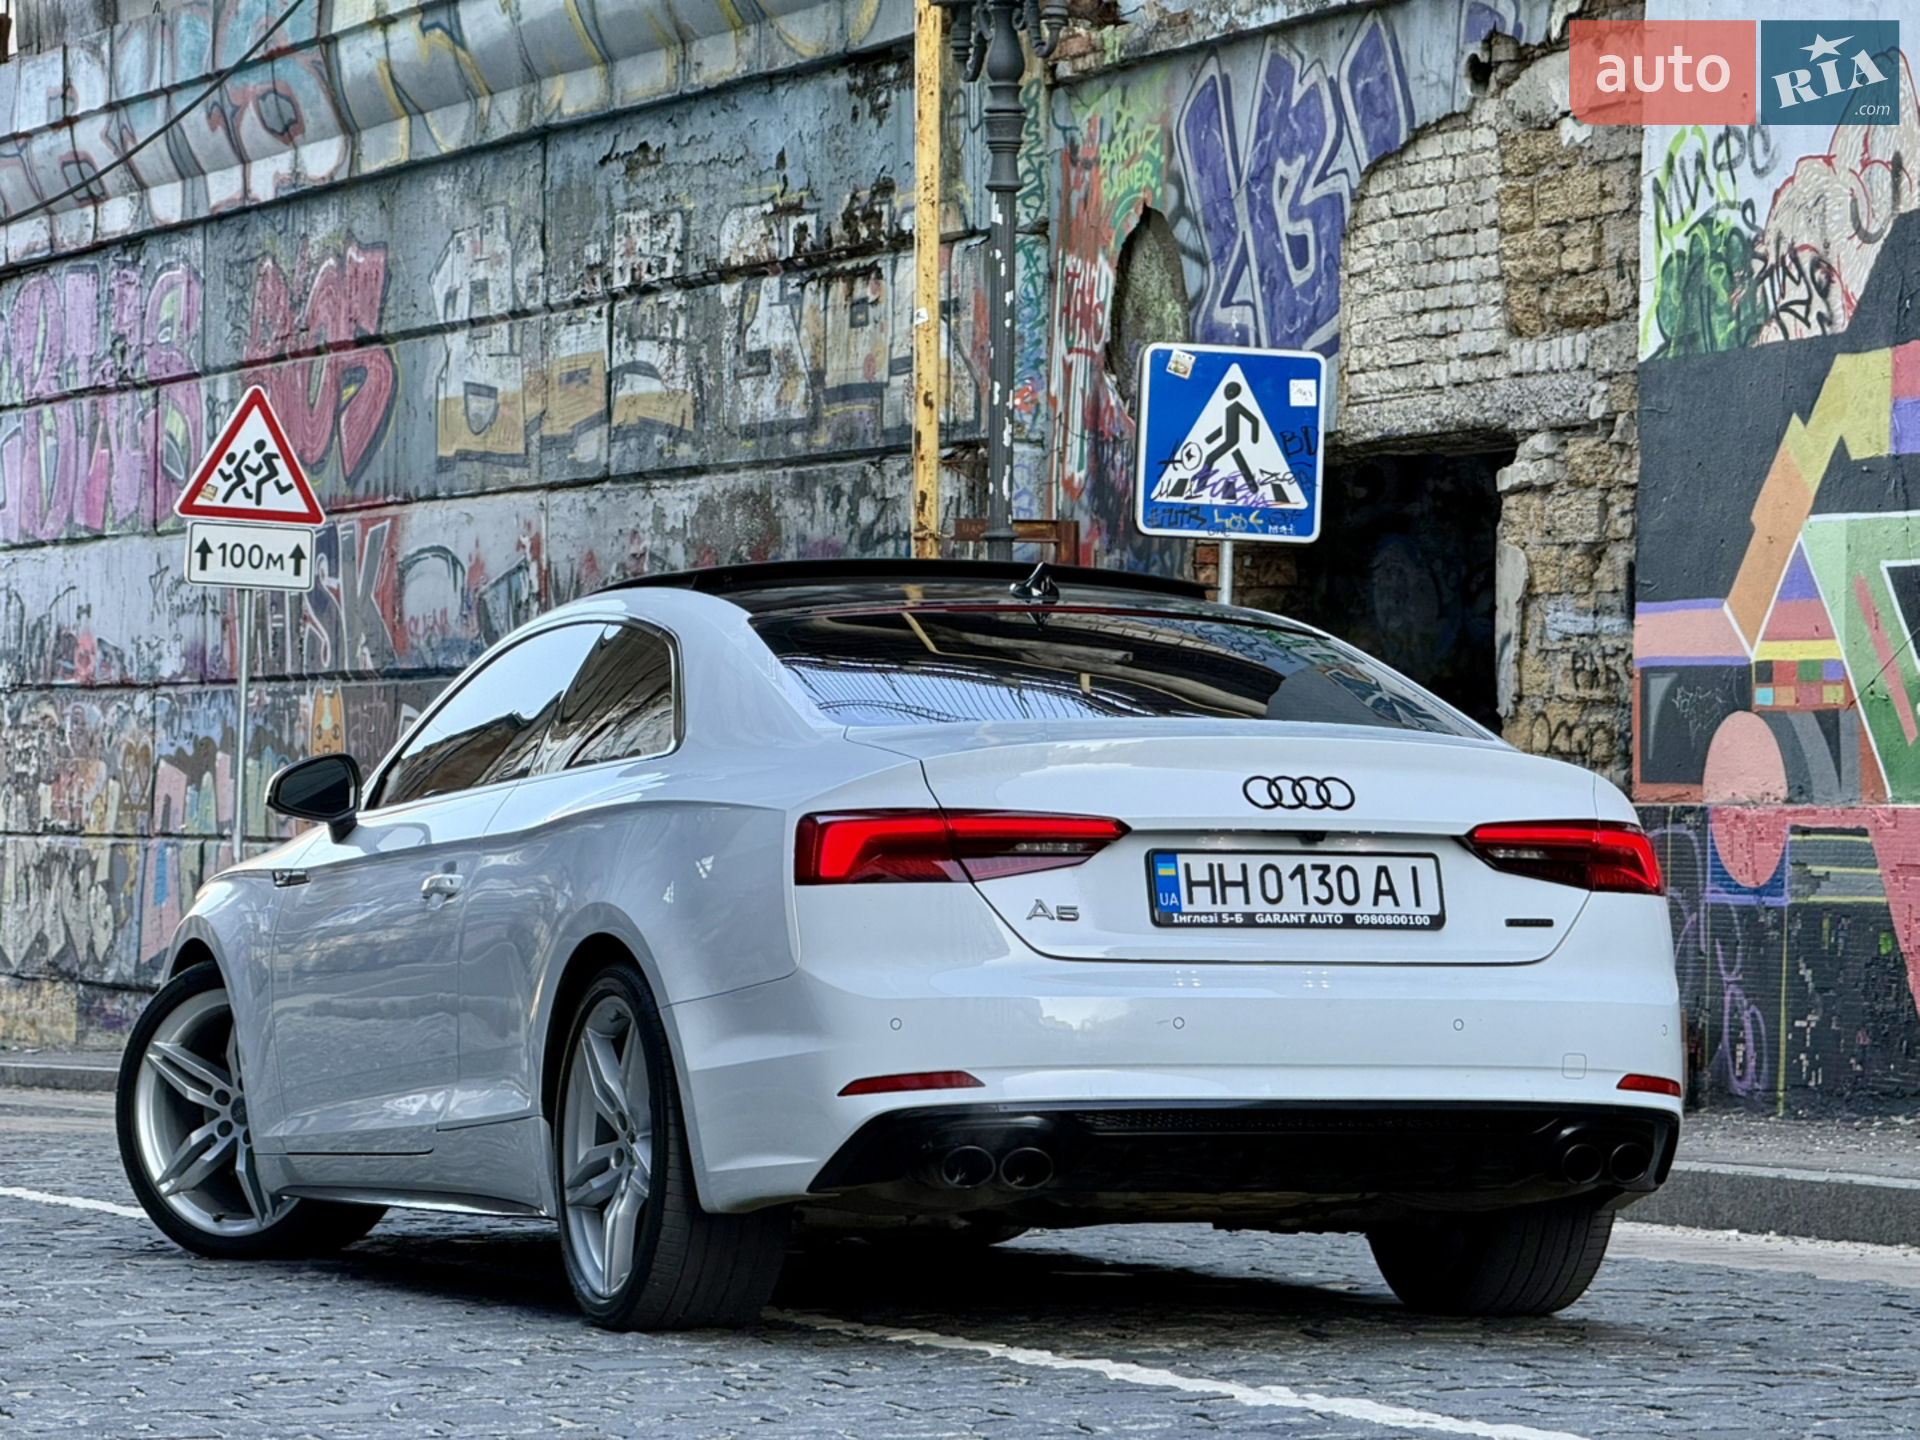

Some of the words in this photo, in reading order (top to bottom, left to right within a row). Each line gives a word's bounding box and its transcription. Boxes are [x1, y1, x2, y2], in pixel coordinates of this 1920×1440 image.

[1159, 892, 1180, 907] UA
[1026, 898, 1080, 922] A5
[1255, 913, 1306, 924] GARANT
[1309, 914, 1344, 924] AUTO
[1354, 914, 1431, 926] 0980800100
